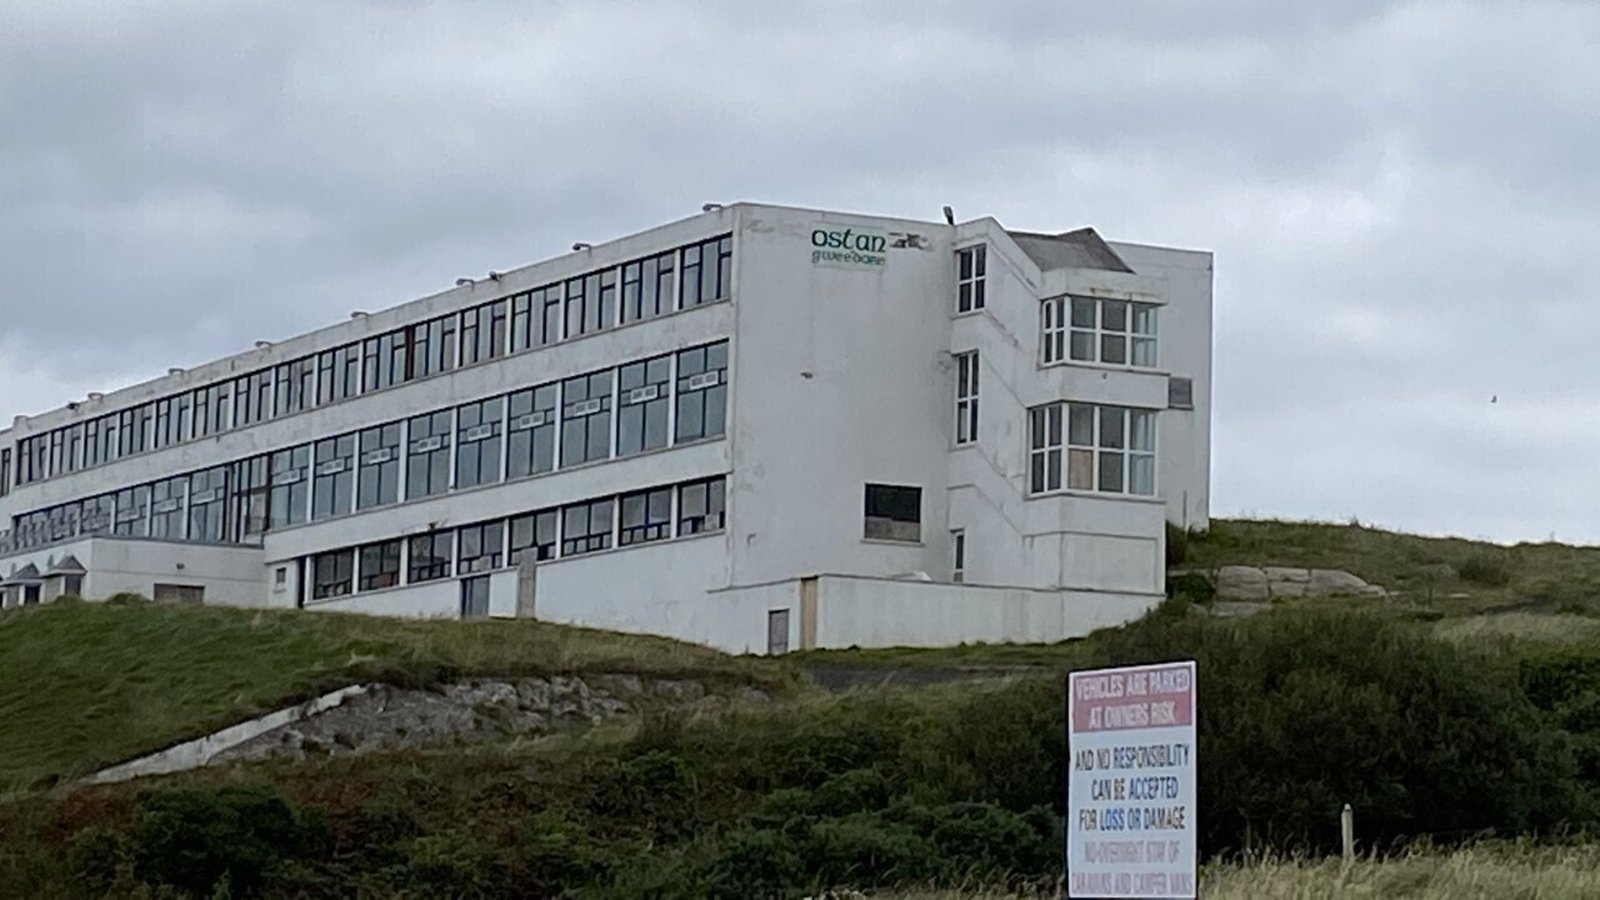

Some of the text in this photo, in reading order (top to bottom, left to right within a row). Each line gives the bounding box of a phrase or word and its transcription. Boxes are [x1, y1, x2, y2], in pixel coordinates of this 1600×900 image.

[811, 228, 886, 253] ostan
[1077, 669, 1190, 700] VEHICLES ARE PARKED
[1089, 706, 1102, 729] AT
[1151, 700, 1176, 725] RISK
[1075, 743, 1190, 771] AND NO RESPONSIBILITY
[1091, 776, 1179, 800] CAN BE ACCEPTED
[1079, 806, 1185, 831] FOR LOSS OR DAMAGE
